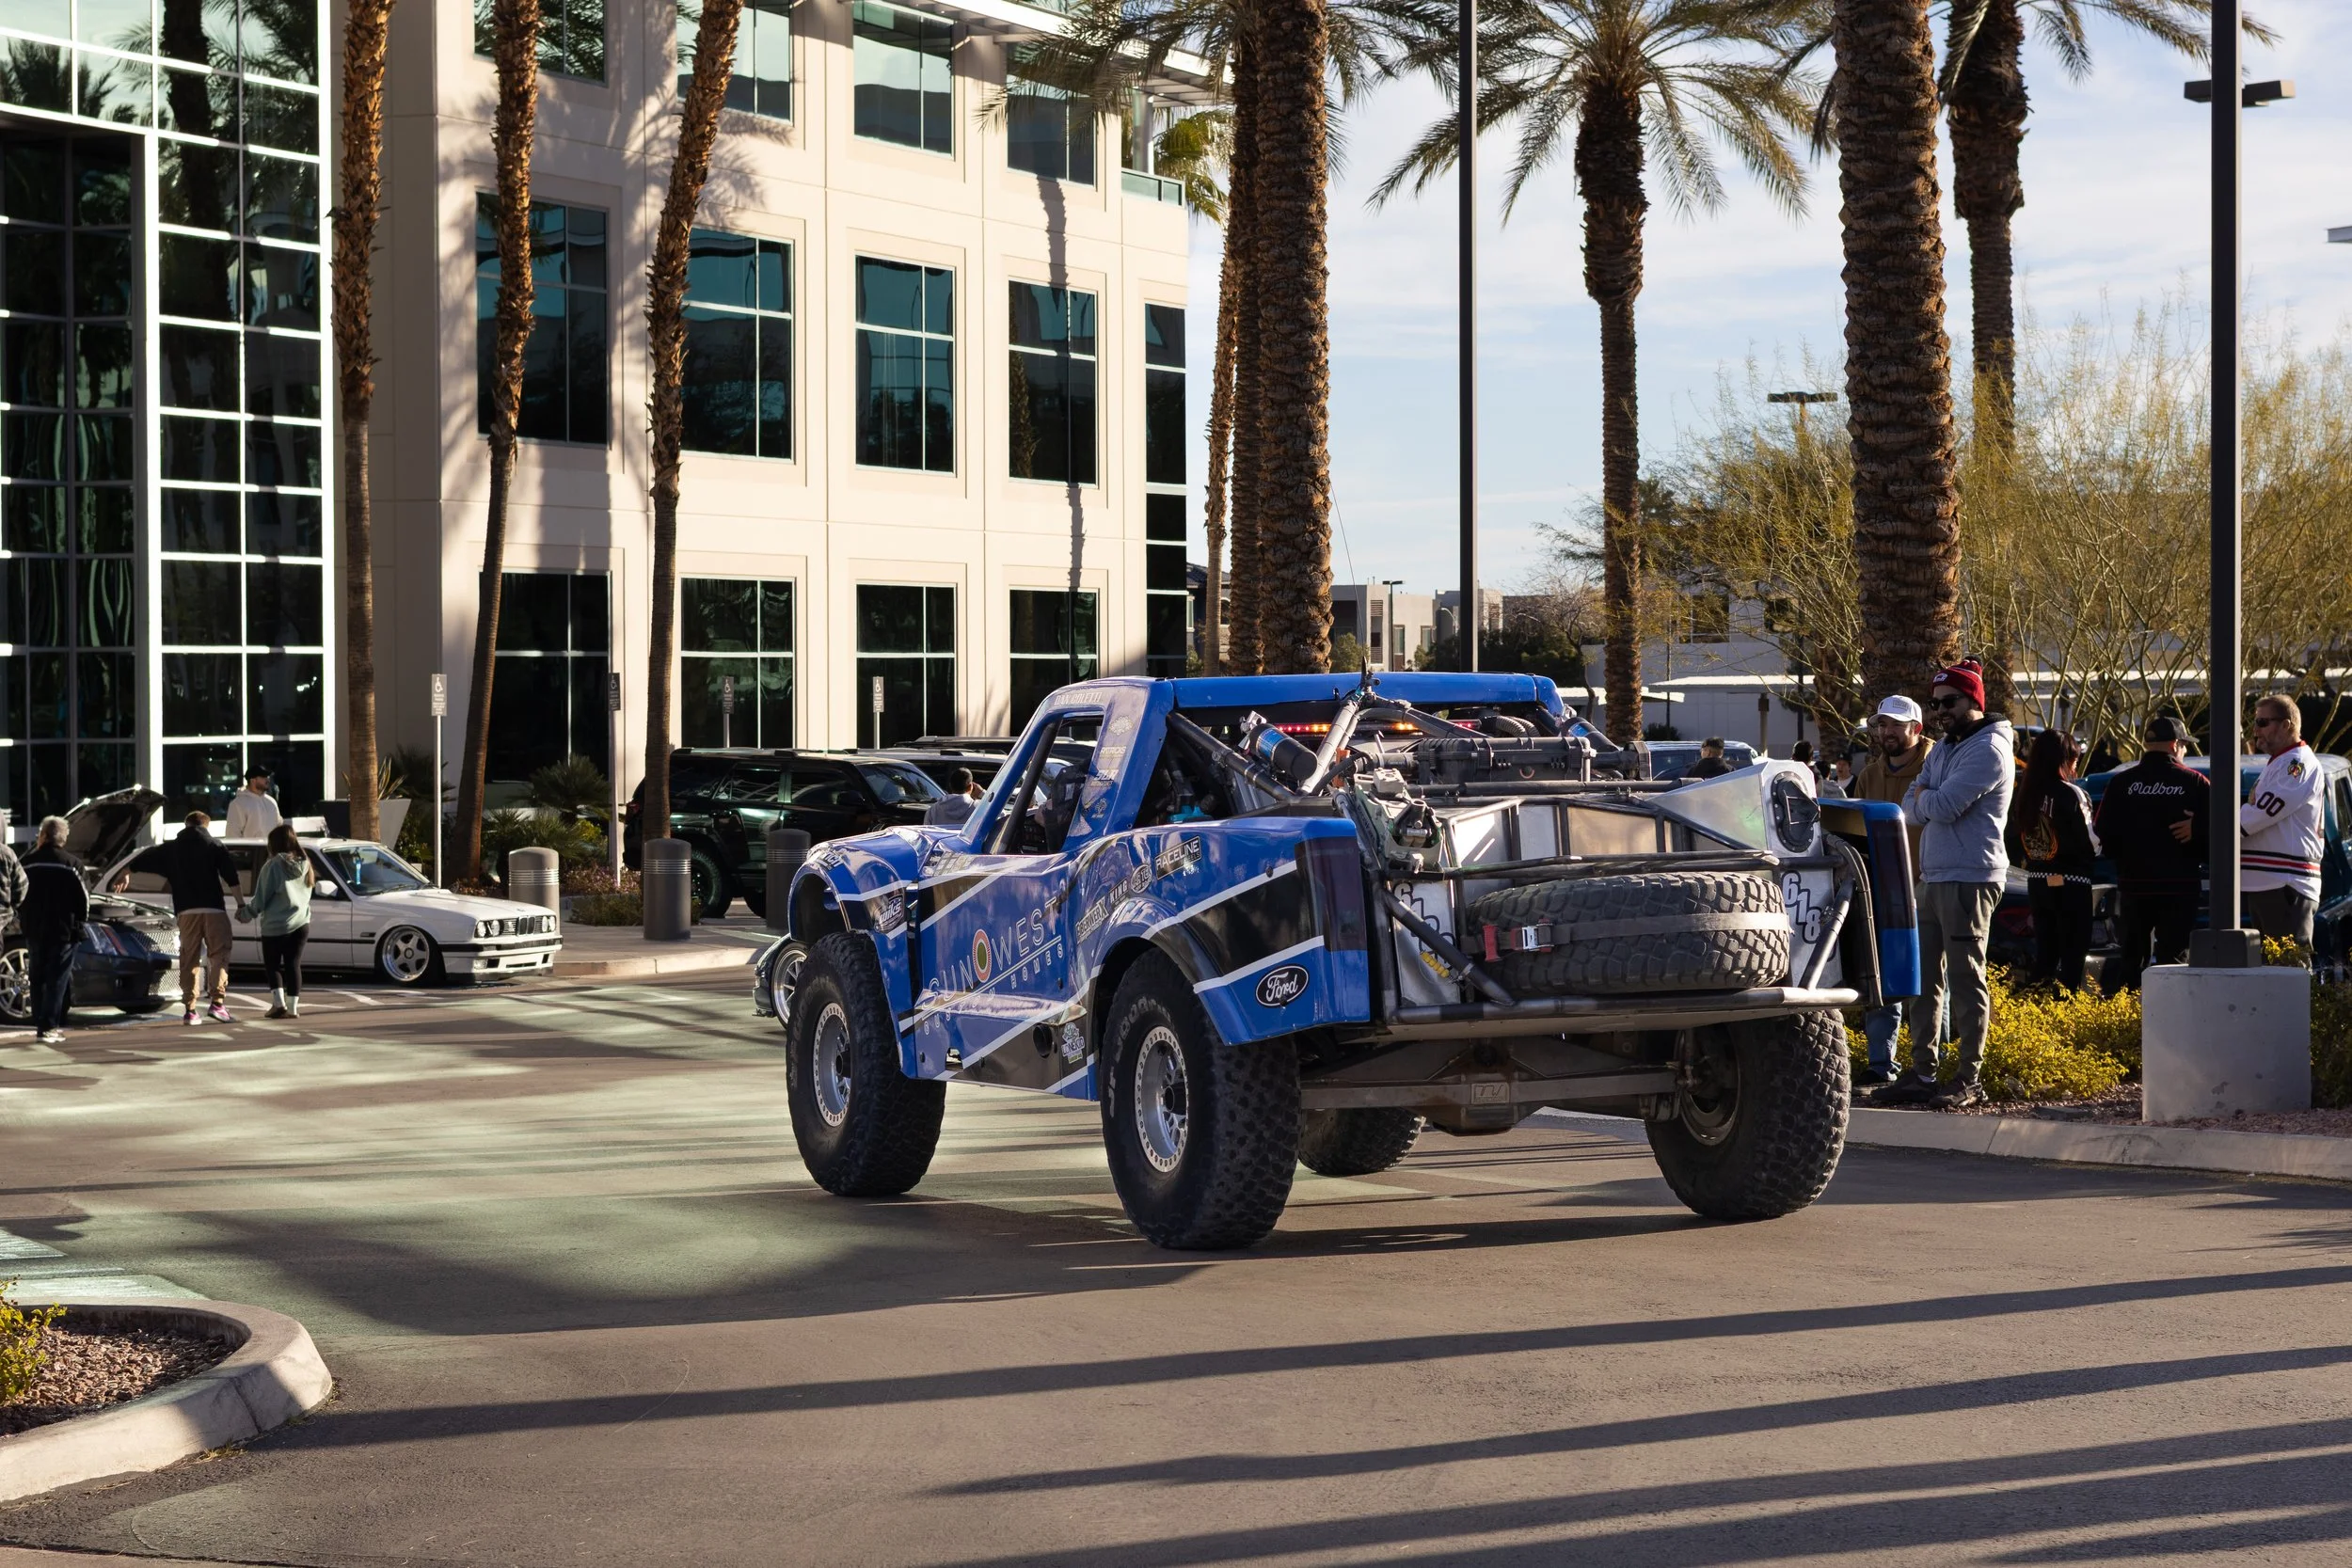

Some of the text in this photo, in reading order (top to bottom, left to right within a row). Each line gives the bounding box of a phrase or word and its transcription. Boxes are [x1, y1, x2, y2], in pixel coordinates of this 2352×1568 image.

[2127, 782, 2185, 795] Malbon
[2256, 791, 2285, 817] 00
[1155, 840, 1200, 870] RACELINE
[1110, 880, 1128, 903] KING
[1781, 870, 1837, 962] 618
[1010, 942, 1064, 990] HOMES
[1265, 972, 1298, 1002] Ford
